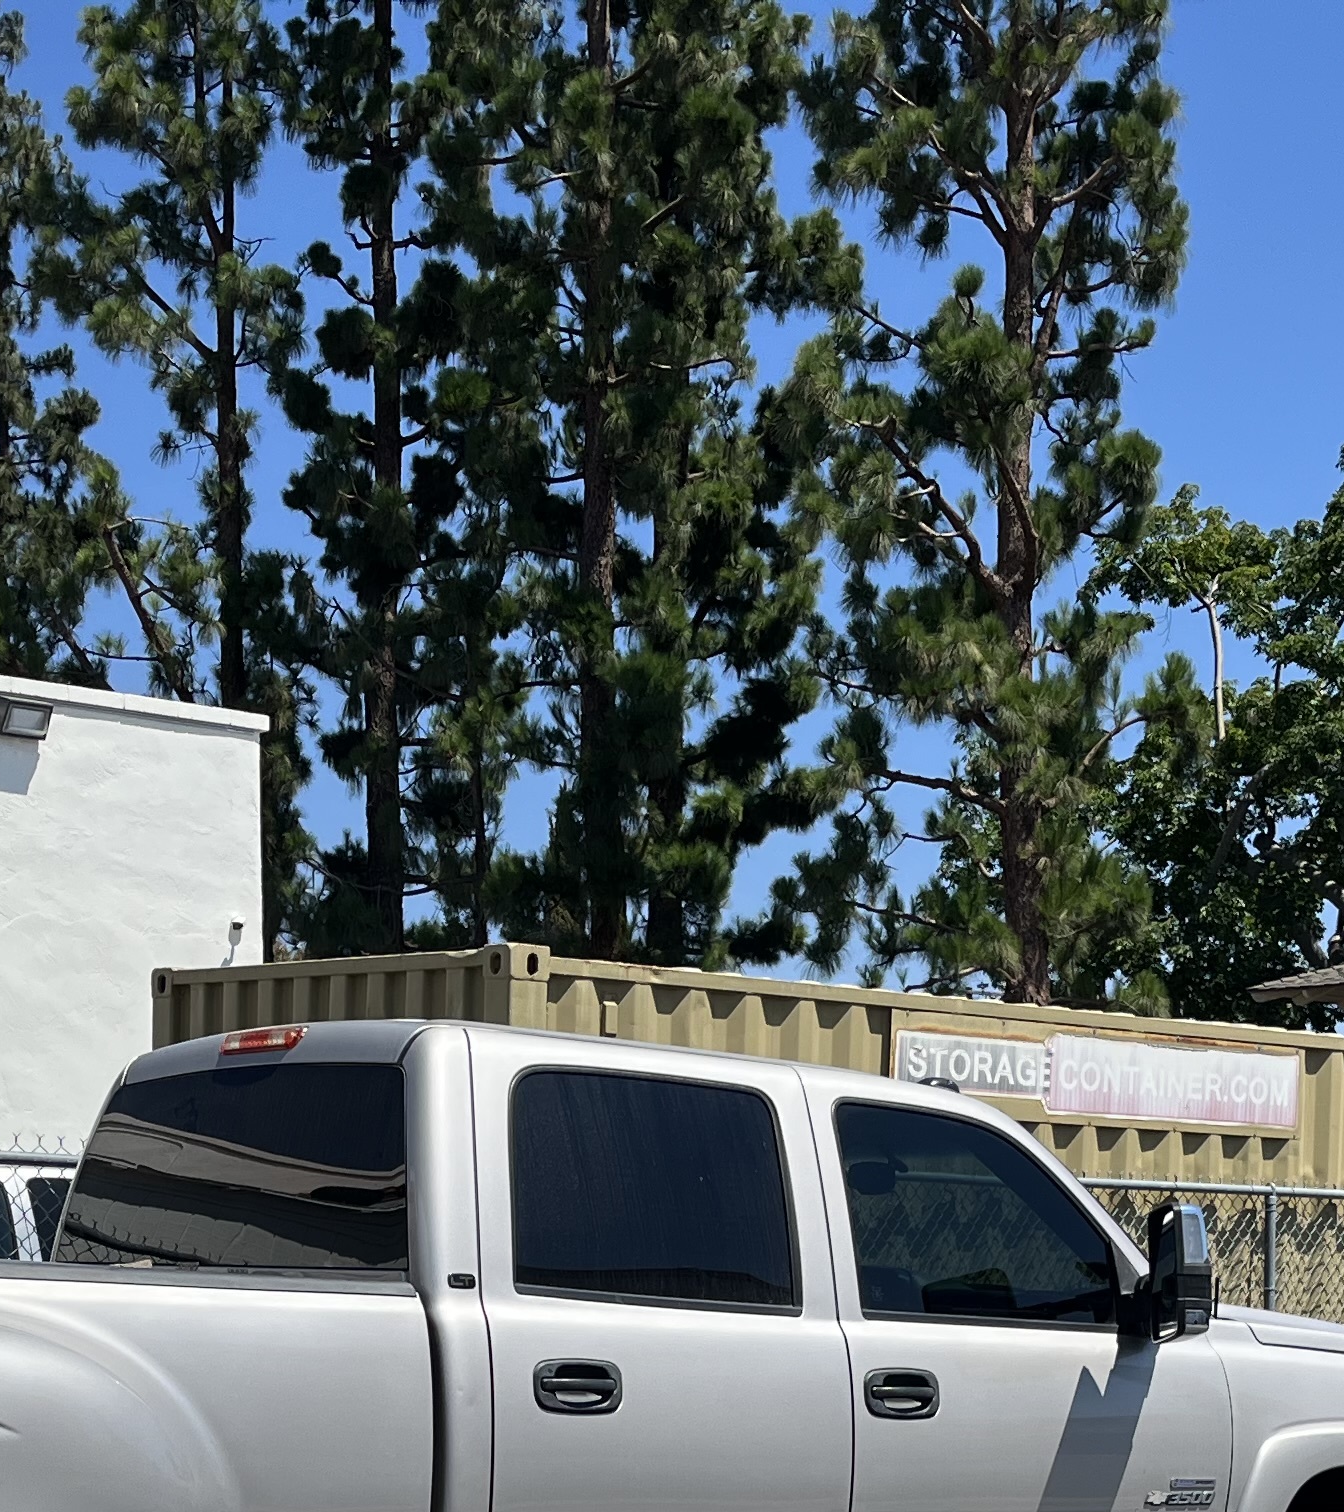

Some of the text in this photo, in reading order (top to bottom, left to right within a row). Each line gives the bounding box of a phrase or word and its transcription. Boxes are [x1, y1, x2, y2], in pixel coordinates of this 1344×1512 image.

[907, 1044, 1291, 1108] STORAGE CONTAINER.COM
[450, 1275, 474, 1287] LT
[1166, 1490, 1216, 1506] 3500
